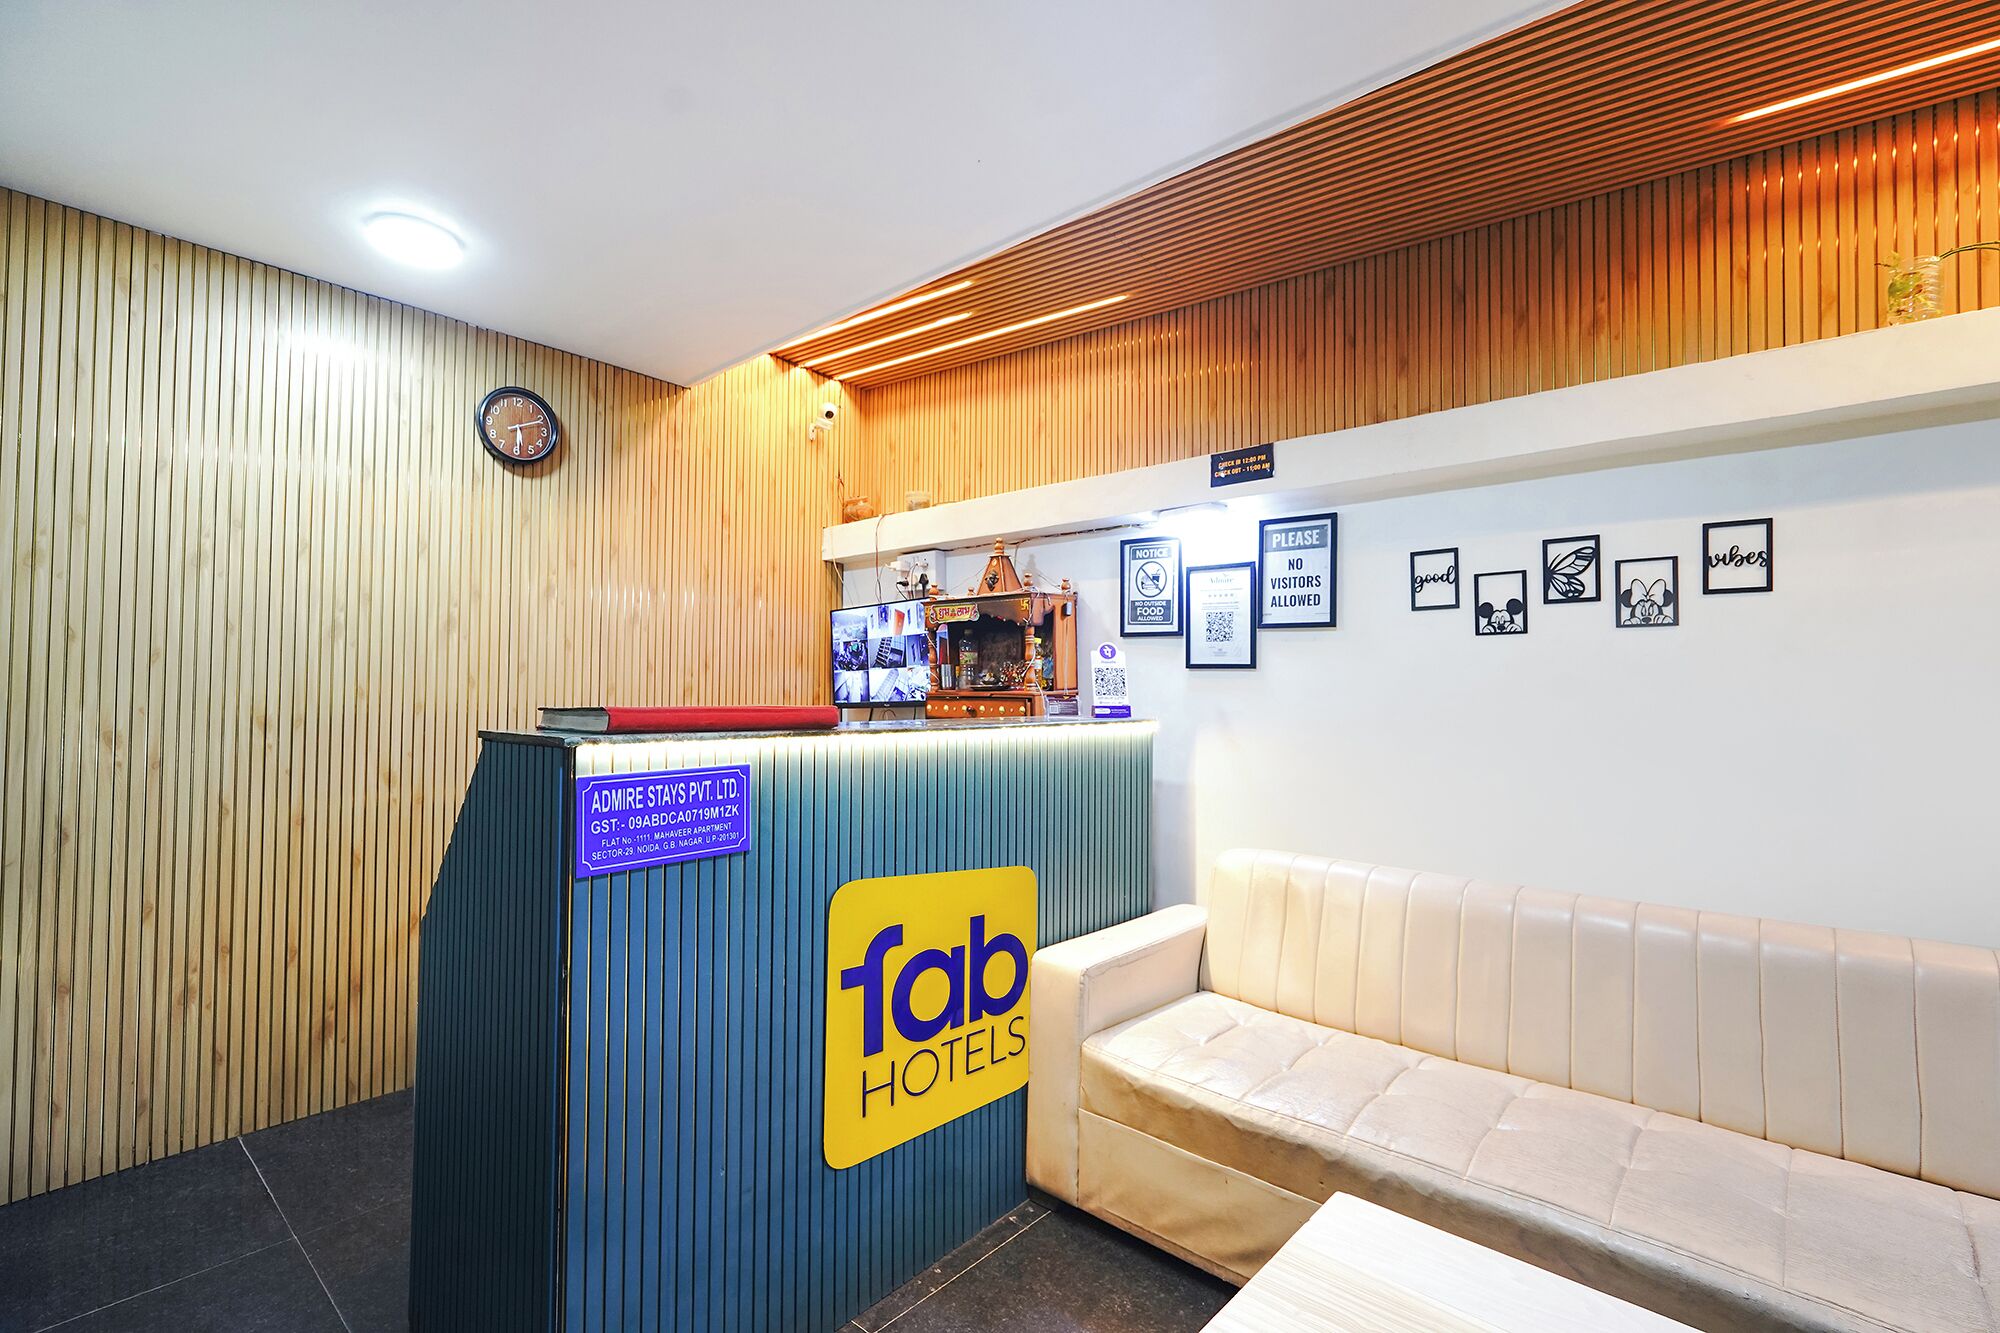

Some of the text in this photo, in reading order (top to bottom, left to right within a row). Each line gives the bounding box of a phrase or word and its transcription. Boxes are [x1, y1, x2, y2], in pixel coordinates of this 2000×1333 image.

[500, 399, 508, 408] 11
[513, 397, 523, 408] 12
[490, 406, 500, 414] 10
[530, 405, 532, 413] 1
[486, 416, 492, 425] 9
[538, 416, 544, 424] 2
[490, 429, 496, 438] 8
[541, 428, 547, 436] 3
[499, 440, 505, 448] 7
[536, 439, 542, 448] 4
[513, 446, 520, 455] 6
[527, 445, 534, 454] 5
[1272, 529, 1320, 548] PLEASE
[1135, 547, 1169, 559] NOTICE
[1707, 545, 1768, 568] vibes
[1288, 557, 1303, 571] NO
[1270, 575, 1321, 590] VISITORS
[1415, 565, 1456, 593] good
[1270, 593, 1321, 607] ALLOWED
[1136, 606, 1164, 616] FOOD
[591, 778, 740, 813] ADMIRE STAYS PVT. LTD.
[590, 804, 740, 835] GST:- 09ABDCA0719M1ZK
[601, 837, 620, 848] FLAT
[654, 828, 692, 840] MAHAVEER
[693, 822, 732, 834] APARTMENT
[840, 914, 1029, 1058] fab
[862, 1015, 1026, 1118] HOTELS
